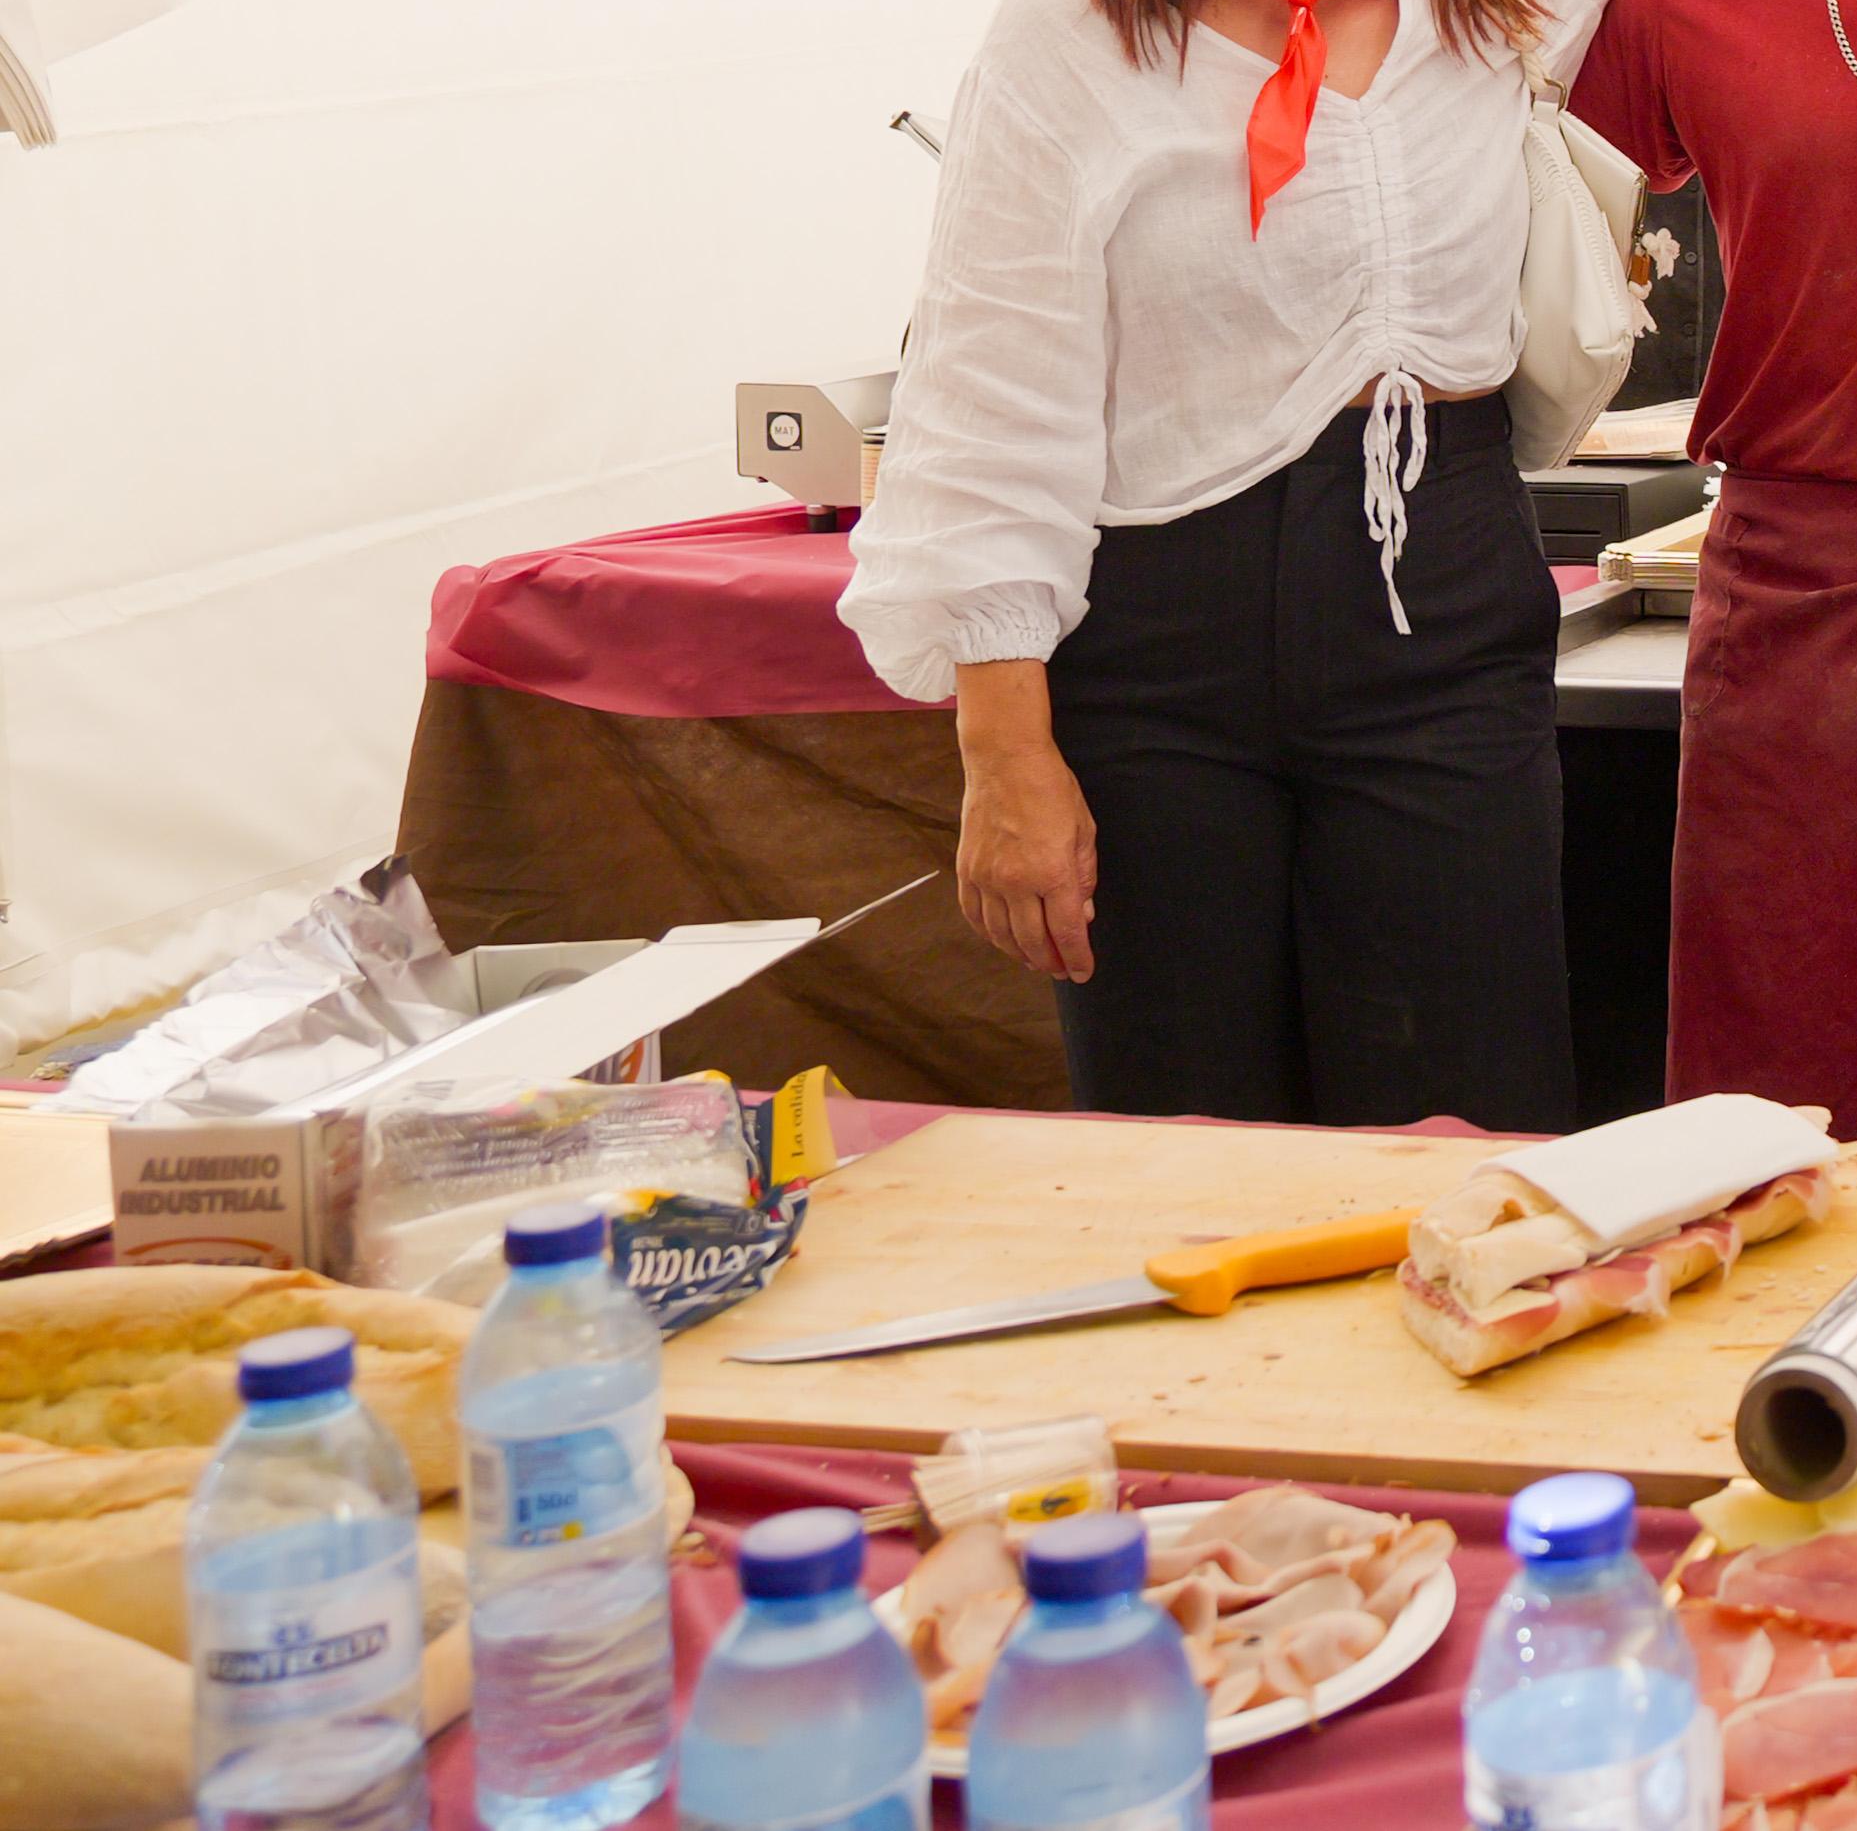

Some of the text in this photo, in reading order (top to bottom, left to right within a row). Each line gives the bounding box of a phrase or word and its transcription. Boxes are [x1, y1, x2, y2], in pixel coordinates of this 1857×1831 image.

[774, 426, 795, 436] MAT
[139, 1153, 282, 1183] ALUMINIO
[119, 1186, 286, 1216] INDUSTRIAL
